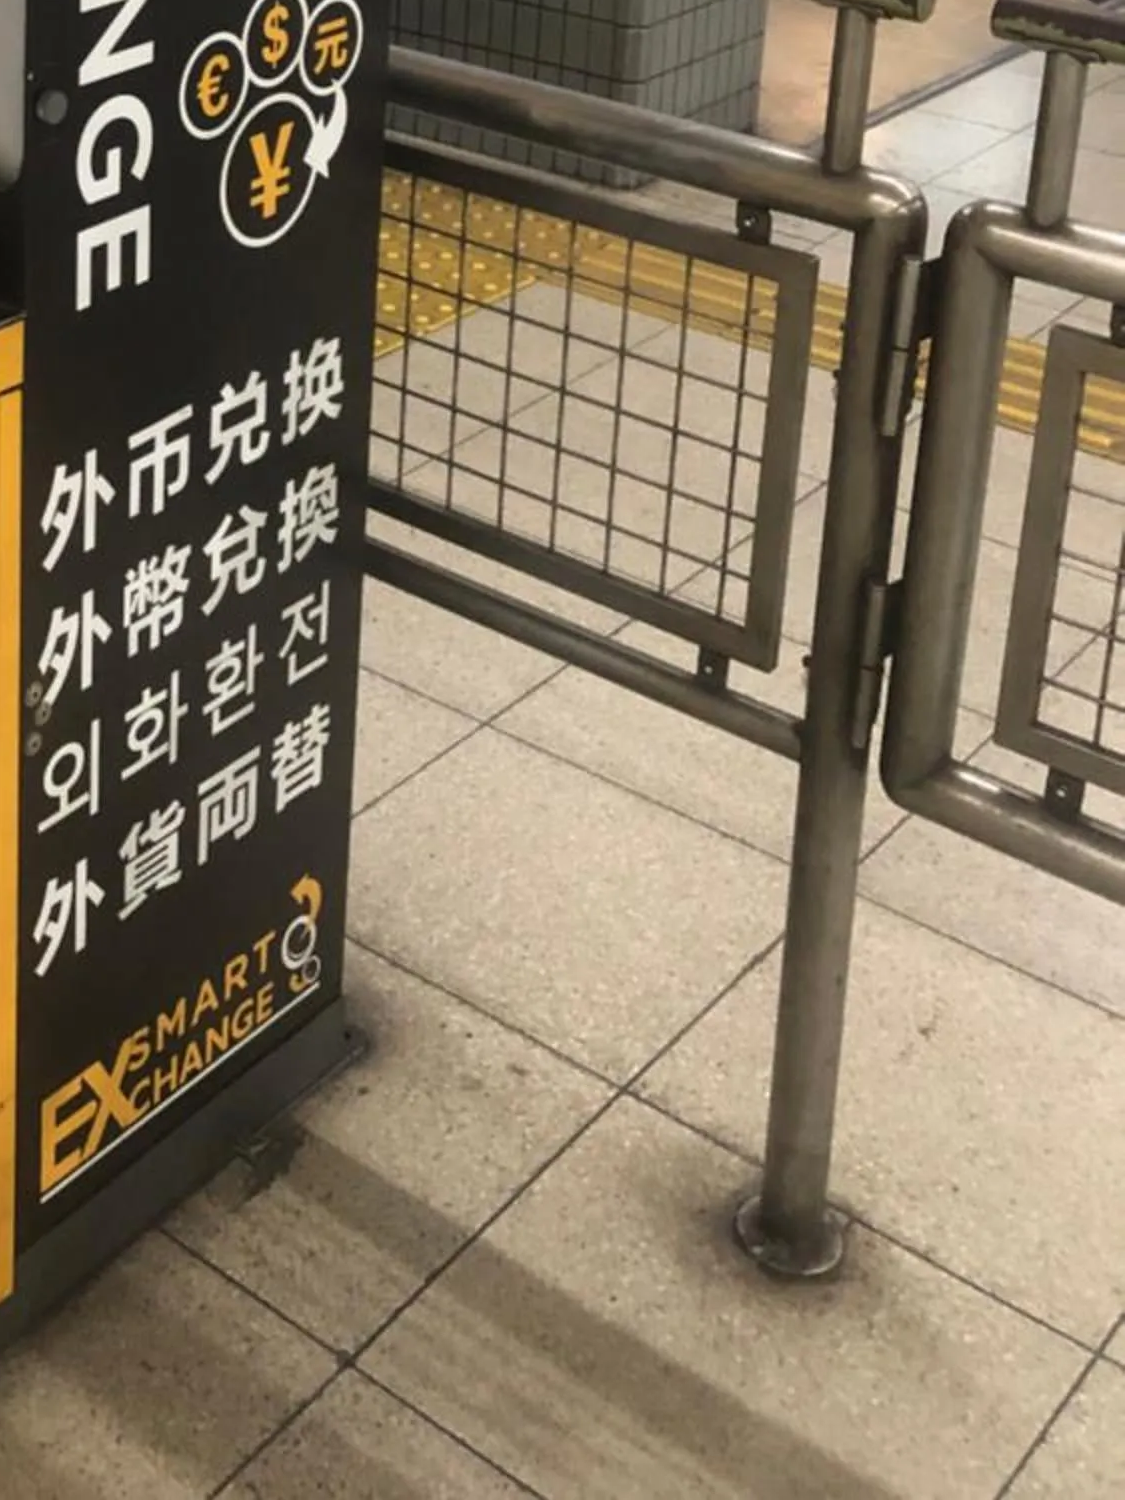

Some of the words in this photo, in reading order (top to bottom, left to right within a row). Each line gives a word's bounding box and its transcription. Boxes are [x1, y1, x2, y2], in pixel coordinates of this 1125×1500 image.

[40, 336, 346, 573] 外币兑换
[37, 578, 331, 834] 외화환전
[31, 702, 332, 979] 外貨両替
[127, 929, 277, 1073] SMART
